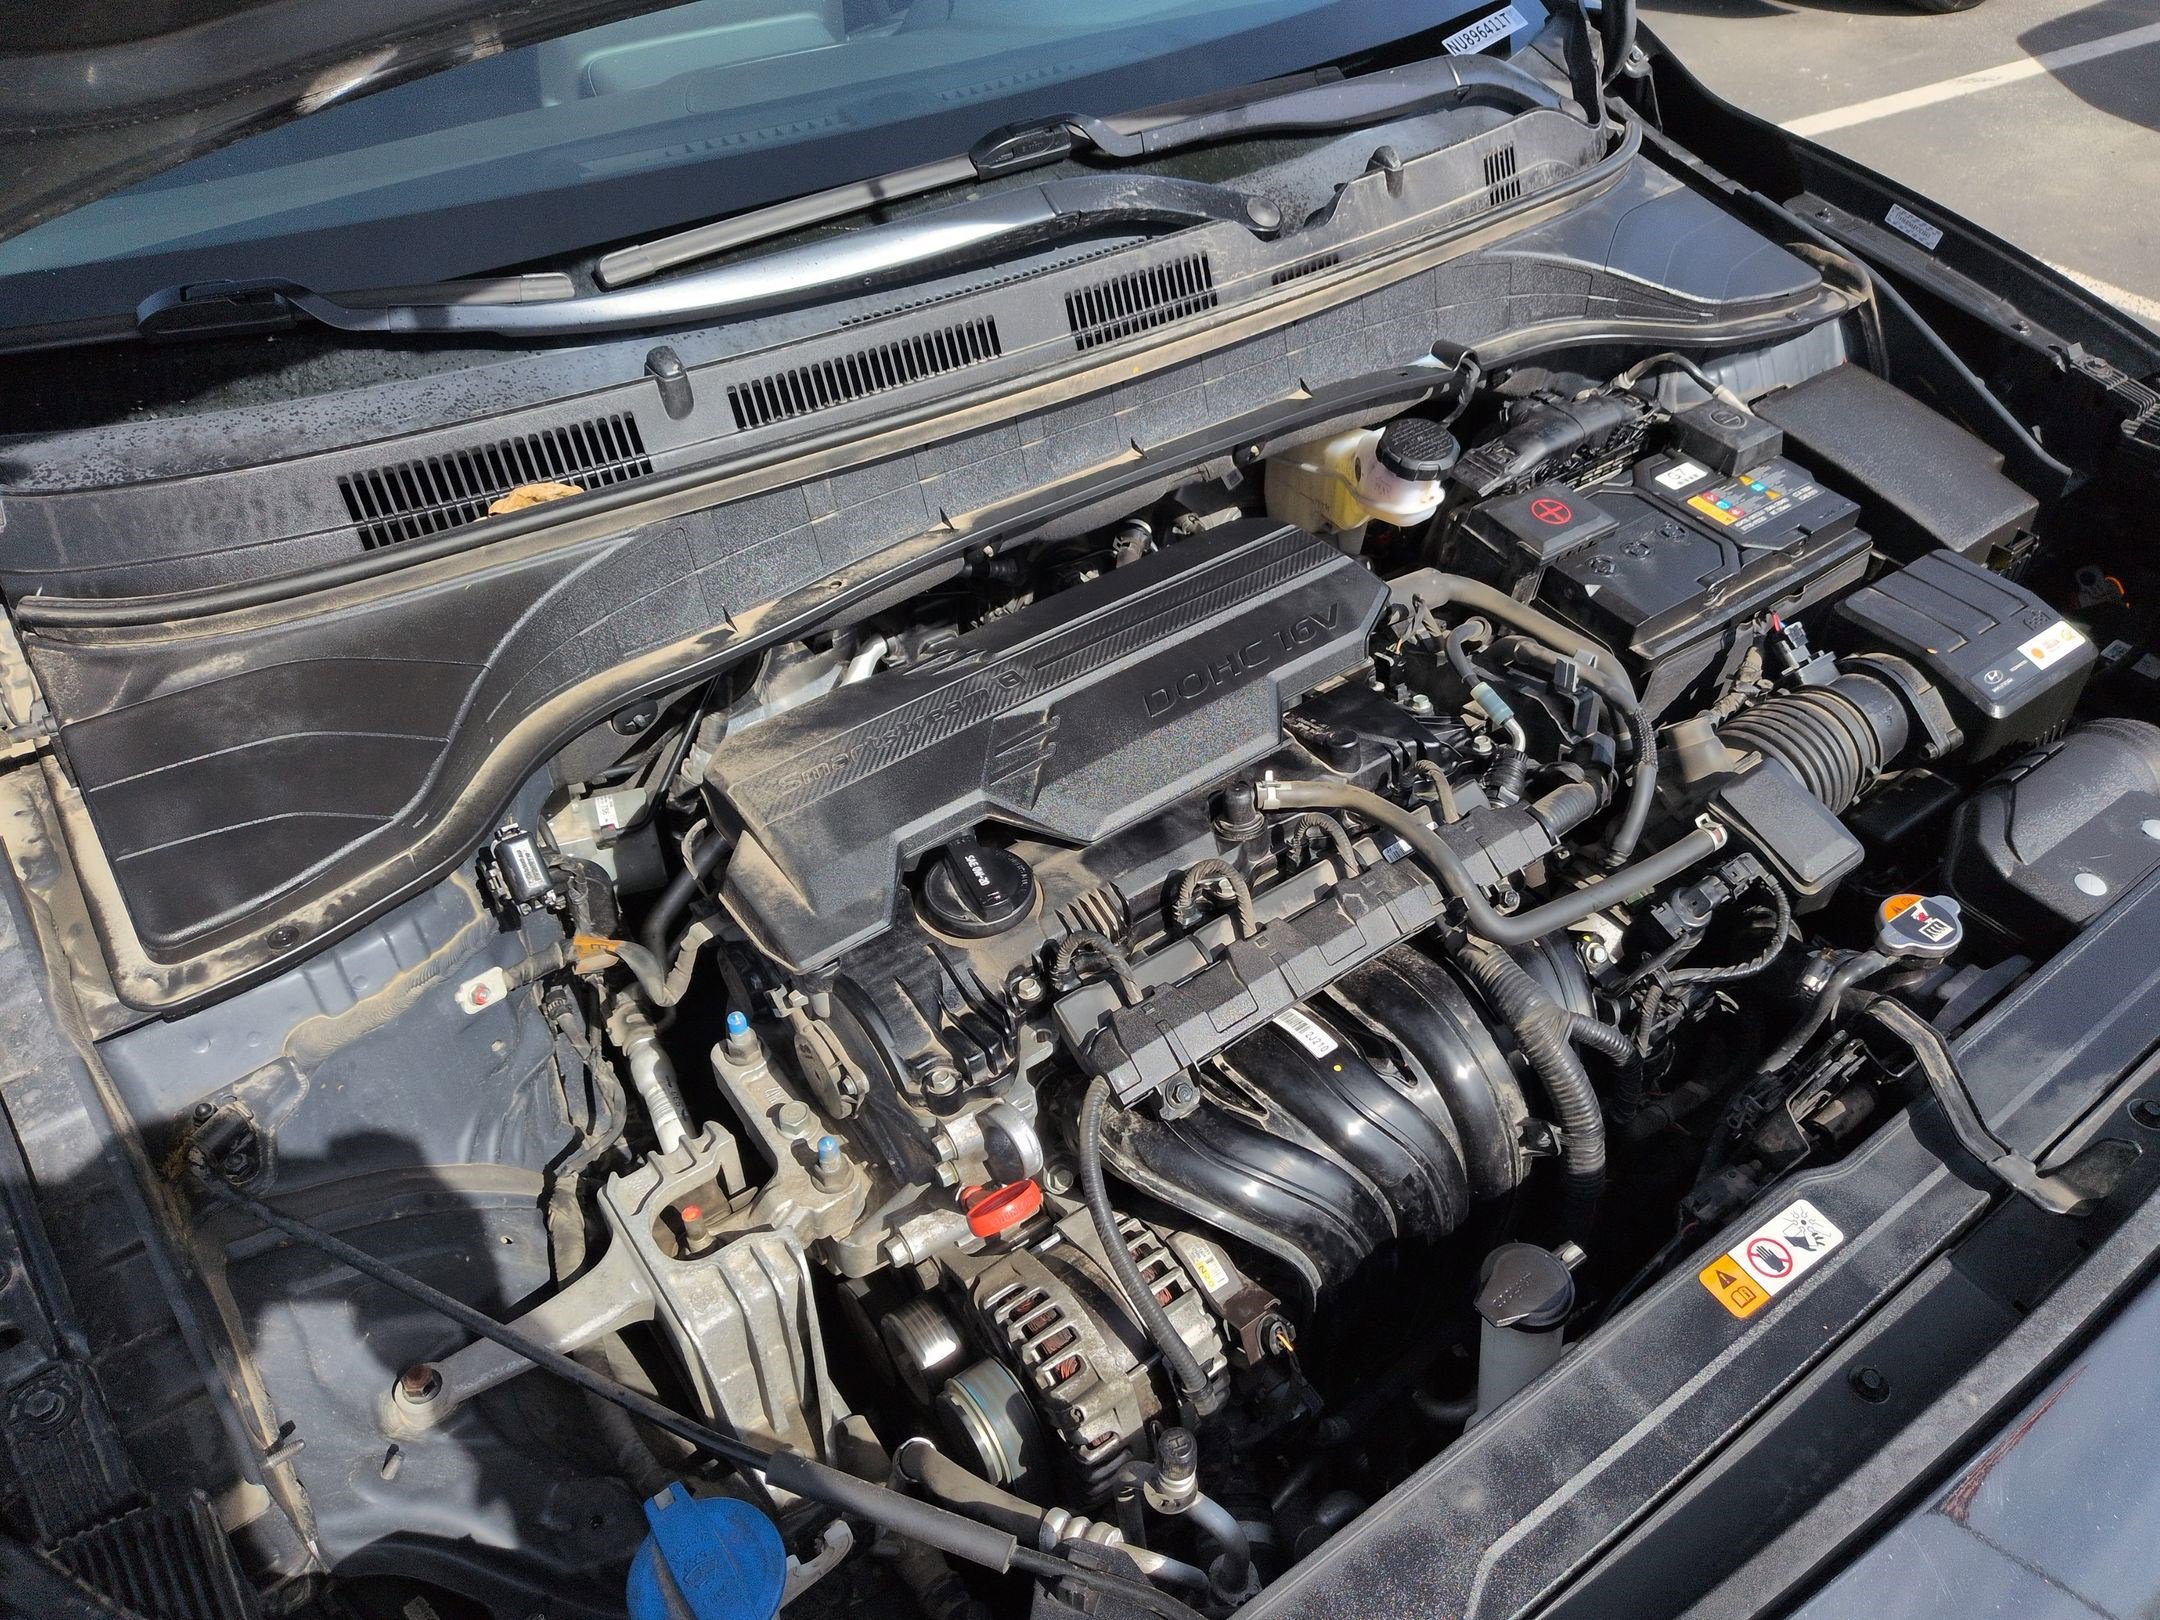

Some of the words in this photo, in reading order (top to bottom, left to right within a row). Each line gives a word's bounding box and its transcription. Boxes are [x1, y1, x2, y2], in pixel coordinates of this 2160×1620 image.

[1446, 12, 1512, 55] NU896411T
[1143, 640, 1271, 718] DOHC
[1273, 602, 1340, 652] 16V
[964, 854, 977, 868] SAE
